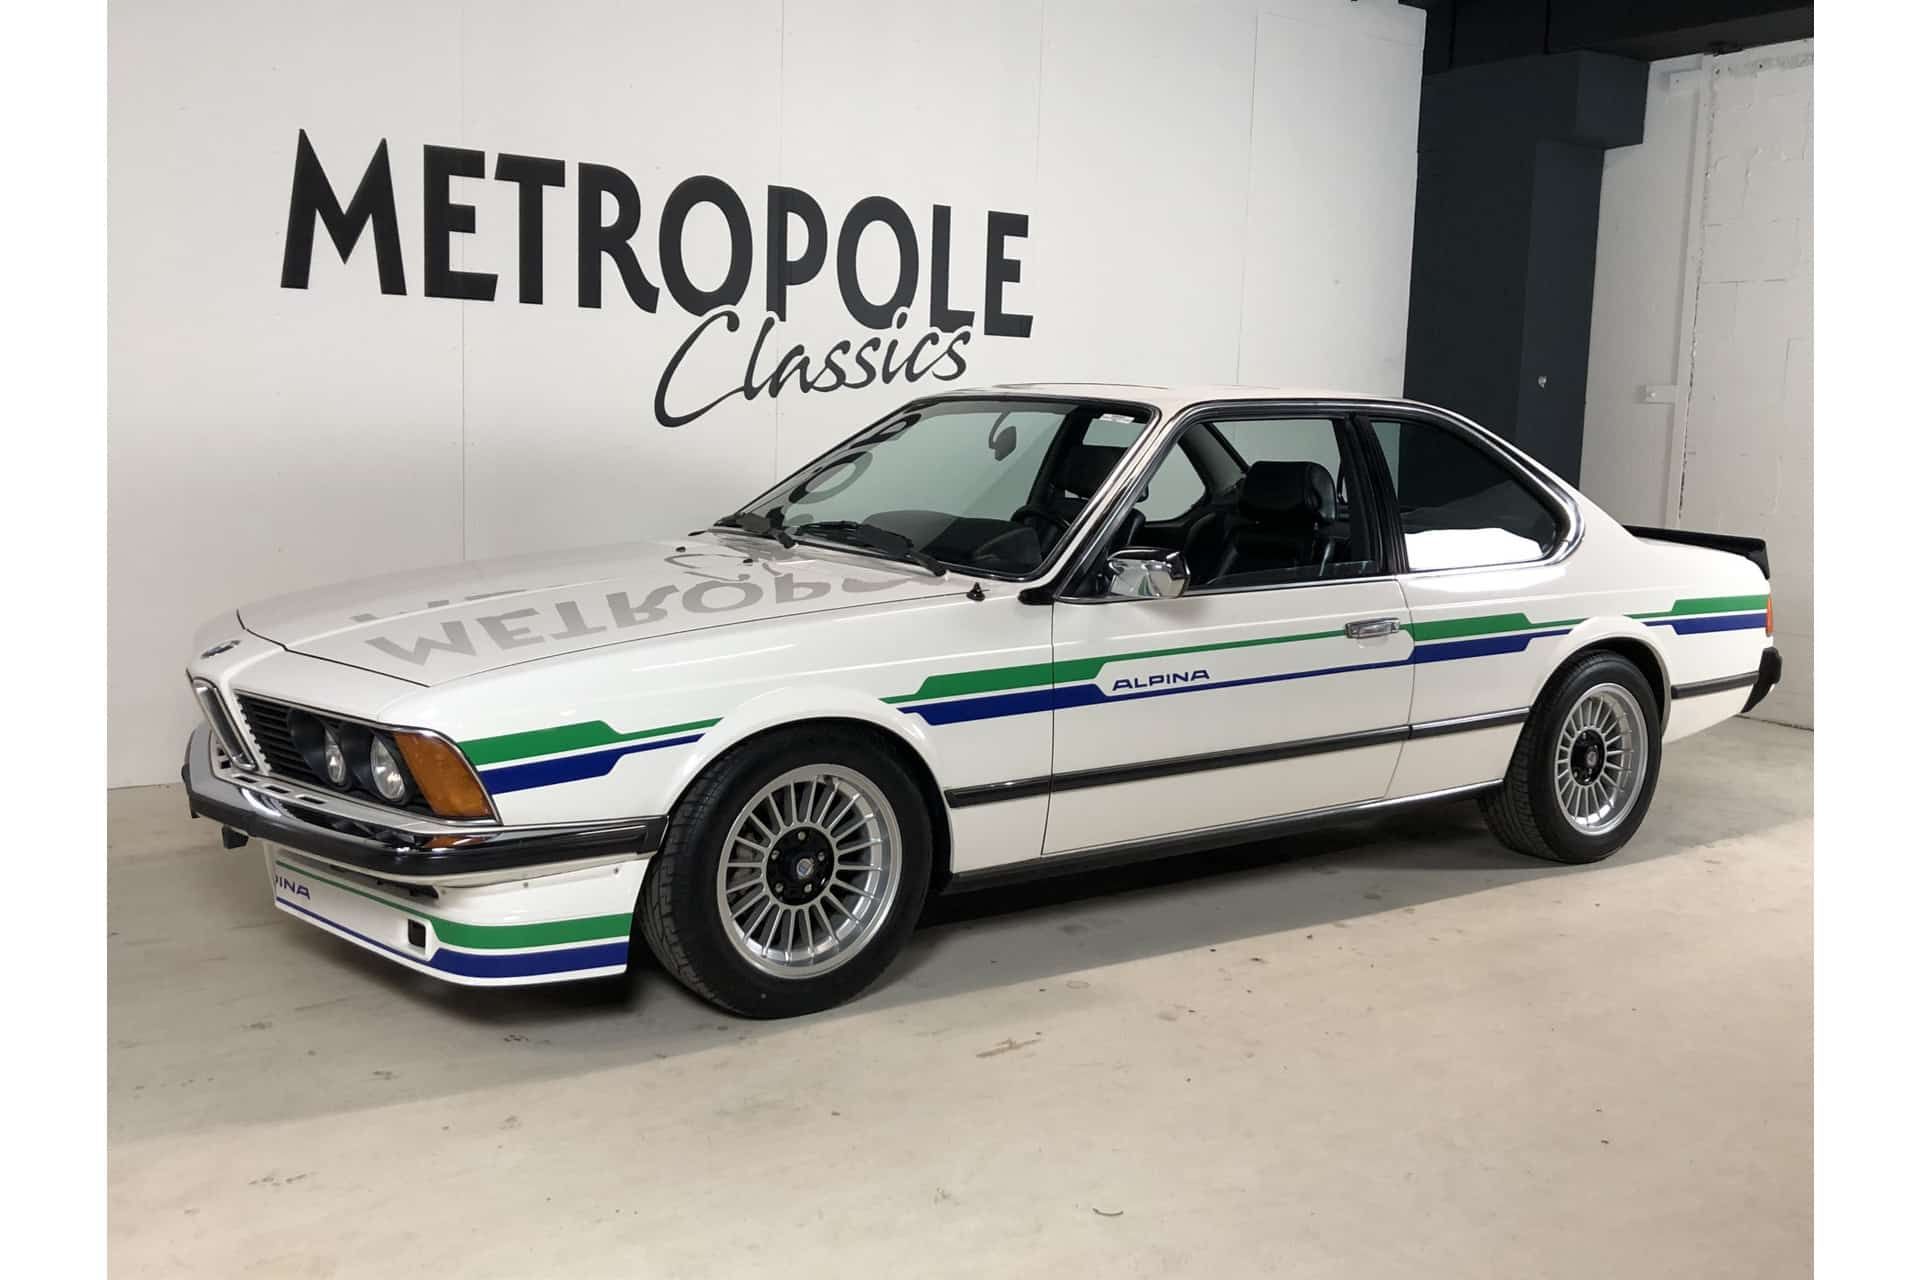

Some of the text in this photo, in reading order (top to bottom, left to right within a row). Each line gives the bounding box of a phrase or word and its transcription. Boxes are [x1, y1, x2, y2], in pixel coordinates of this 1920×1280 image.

[281, 129, 1033, 338] METROPOLE
[654, 310, 972, 428] Classics
[1111, 669, 1211, 692] ALPINA
